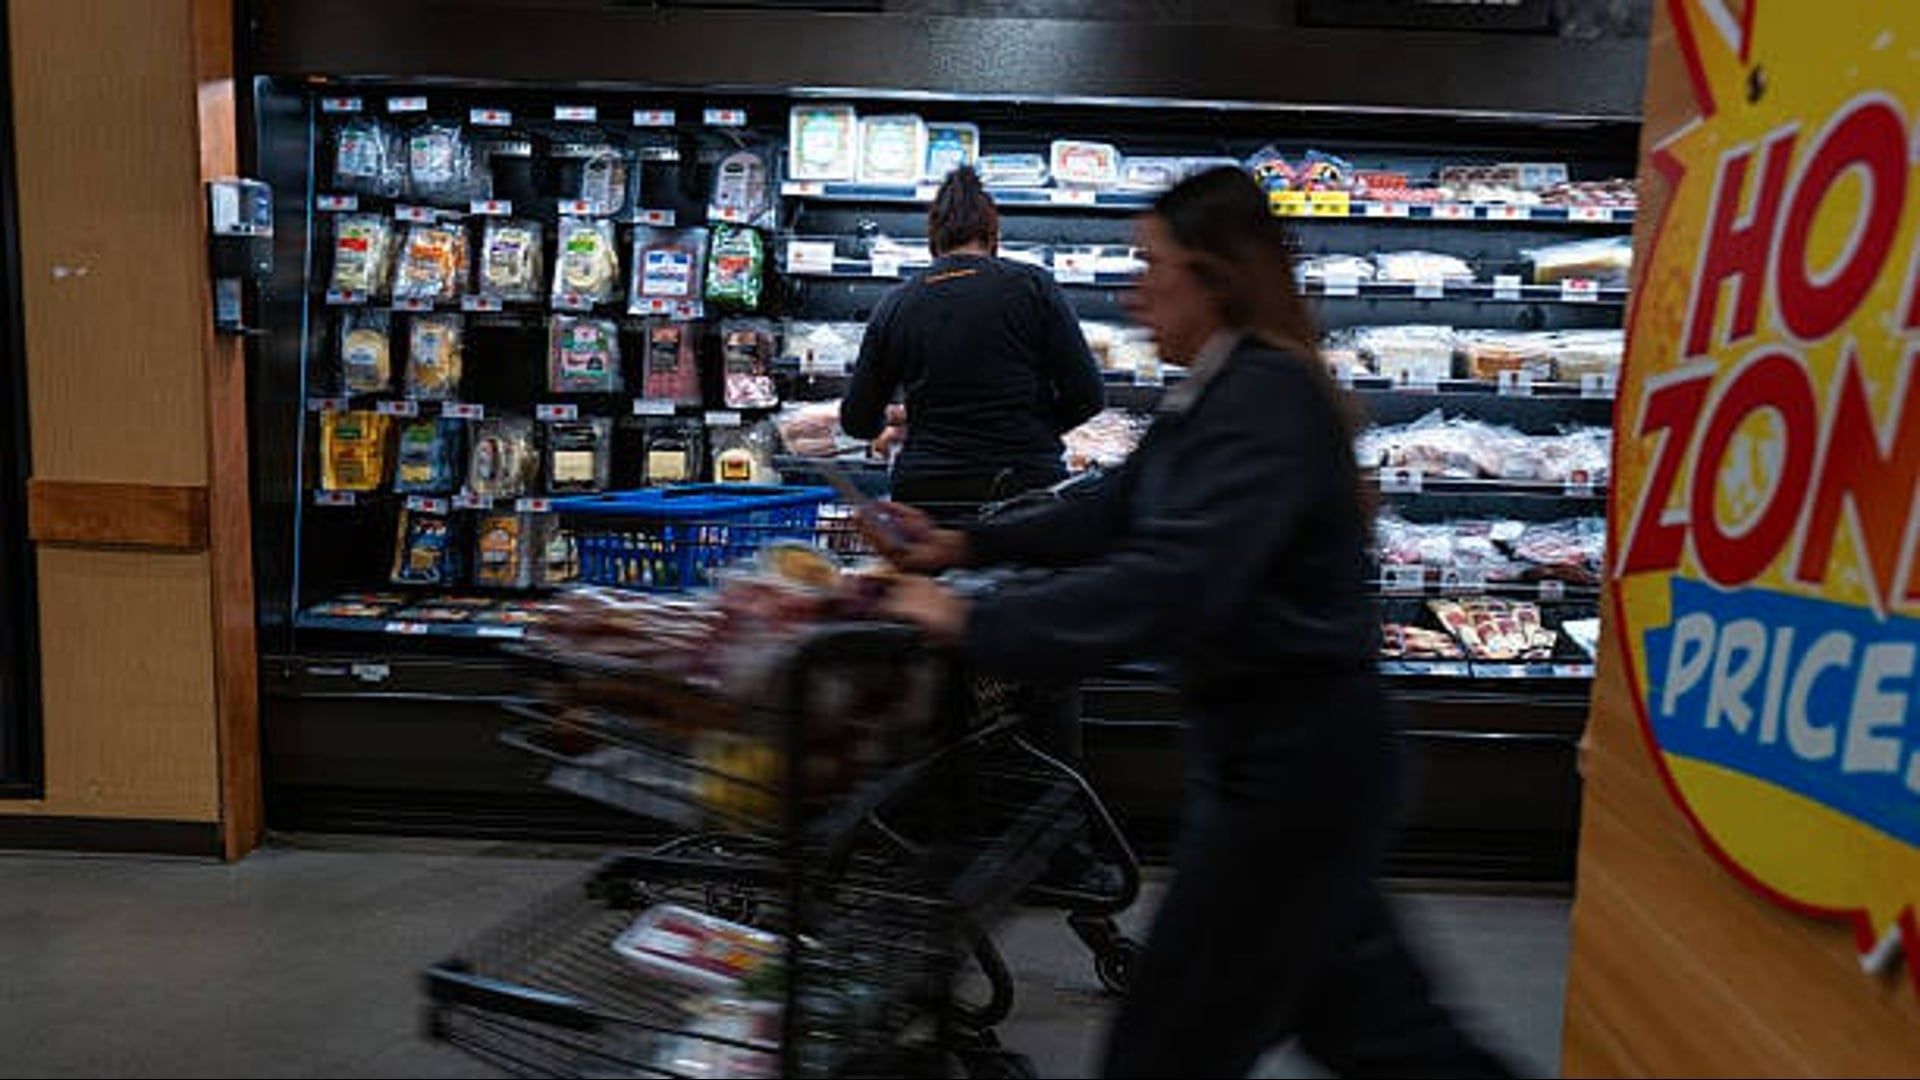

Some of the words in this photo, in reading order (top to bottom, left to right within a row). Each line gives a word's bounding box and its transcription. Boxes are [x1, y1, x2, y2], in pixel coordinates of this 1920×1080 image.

[1682, 92, 1920, 360] HO
[1614, 338, 1920, 618] ZON
[1661, 612, 1920, 795] PRICE
